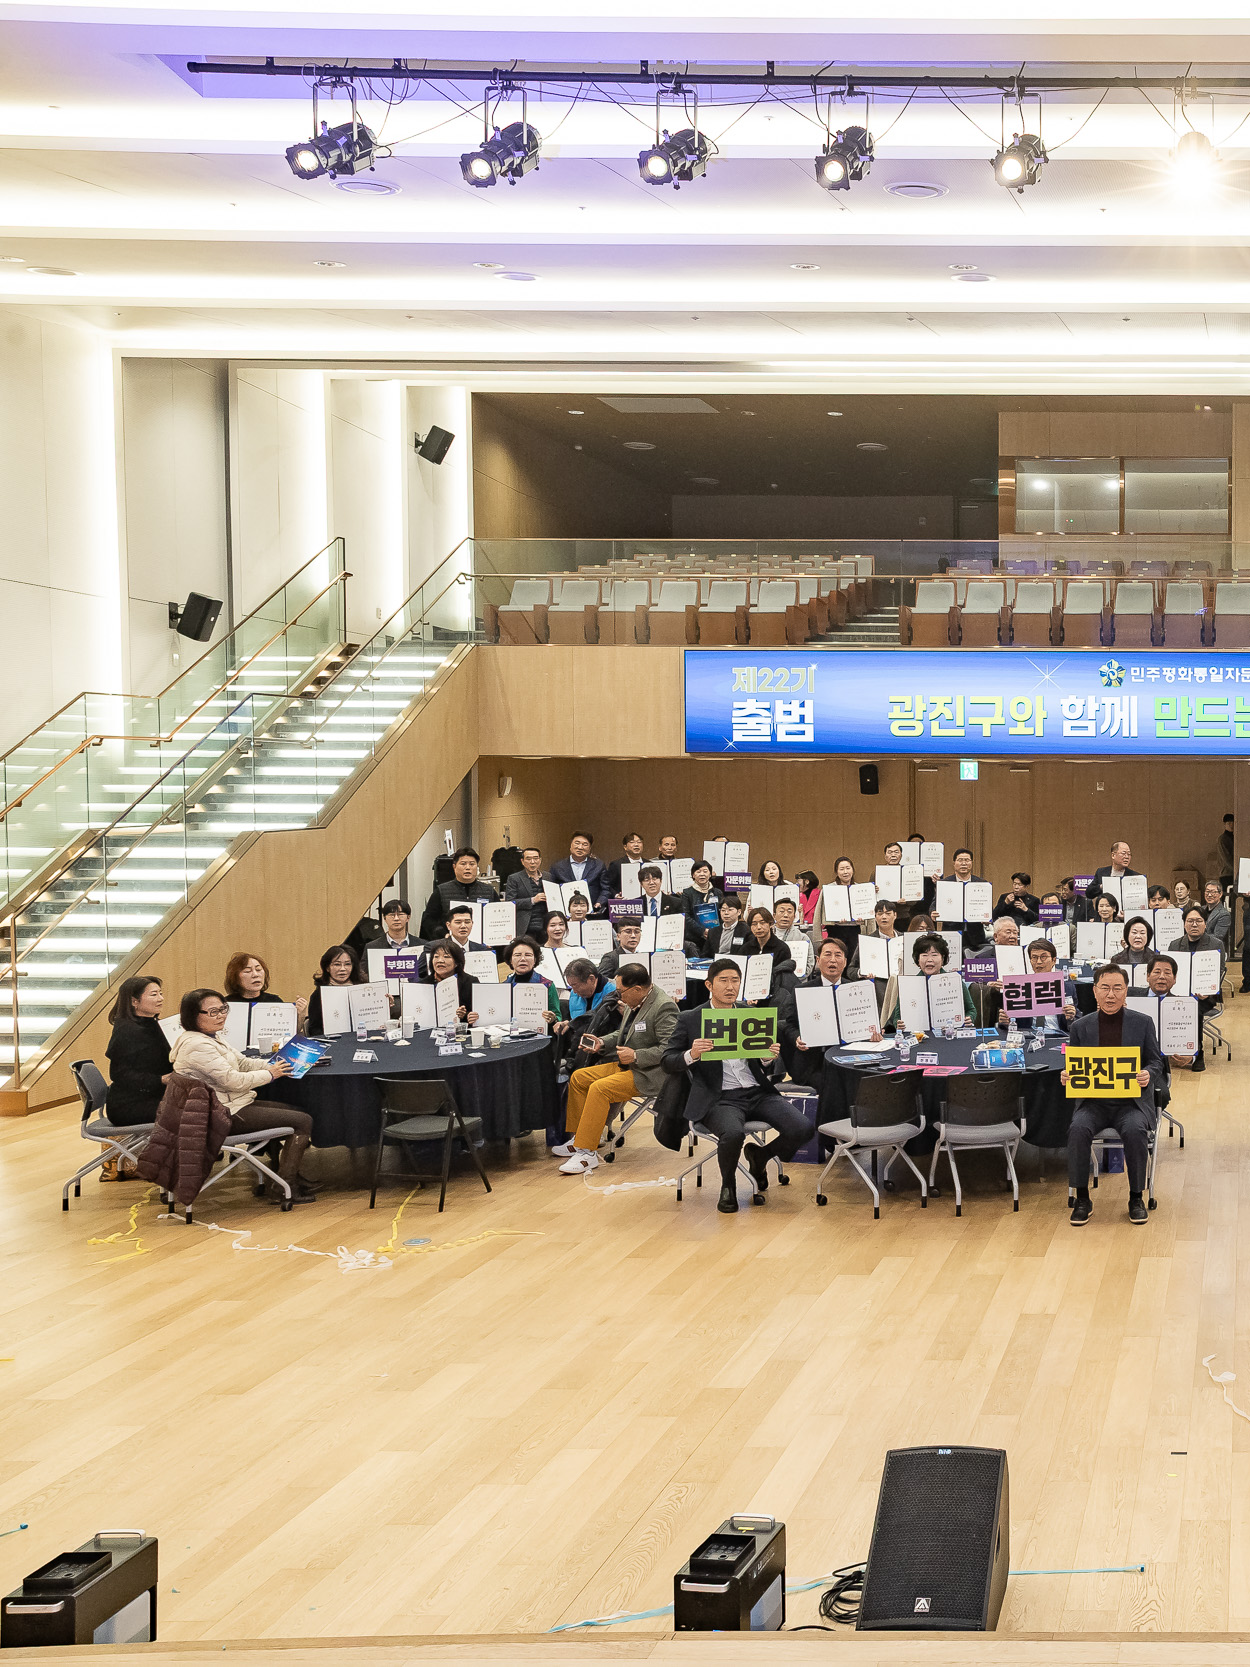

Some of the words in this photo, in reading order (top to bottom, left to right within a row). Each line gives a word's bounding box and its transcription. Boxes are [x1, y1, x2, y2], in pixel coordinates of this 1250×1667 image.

[732, 667, 815, 693] 제22기
[732, 699, 815, 742] 출범
[888, 695, 1047, 737] 광진구와
[1060, 695, 1138, 737] 함께
[725, 875, 752, 885] 자문위원
[609, 904, 644, 914] 자문위원
[386, 959, 416, 970] 부회장
[967, 963, 995, 973] 내빈석
[1004, 979, 1063, 1012] 협력
[704, 1017, 775, 1052] 번영
[1068, 1056, 1138, 1090] 광진구
